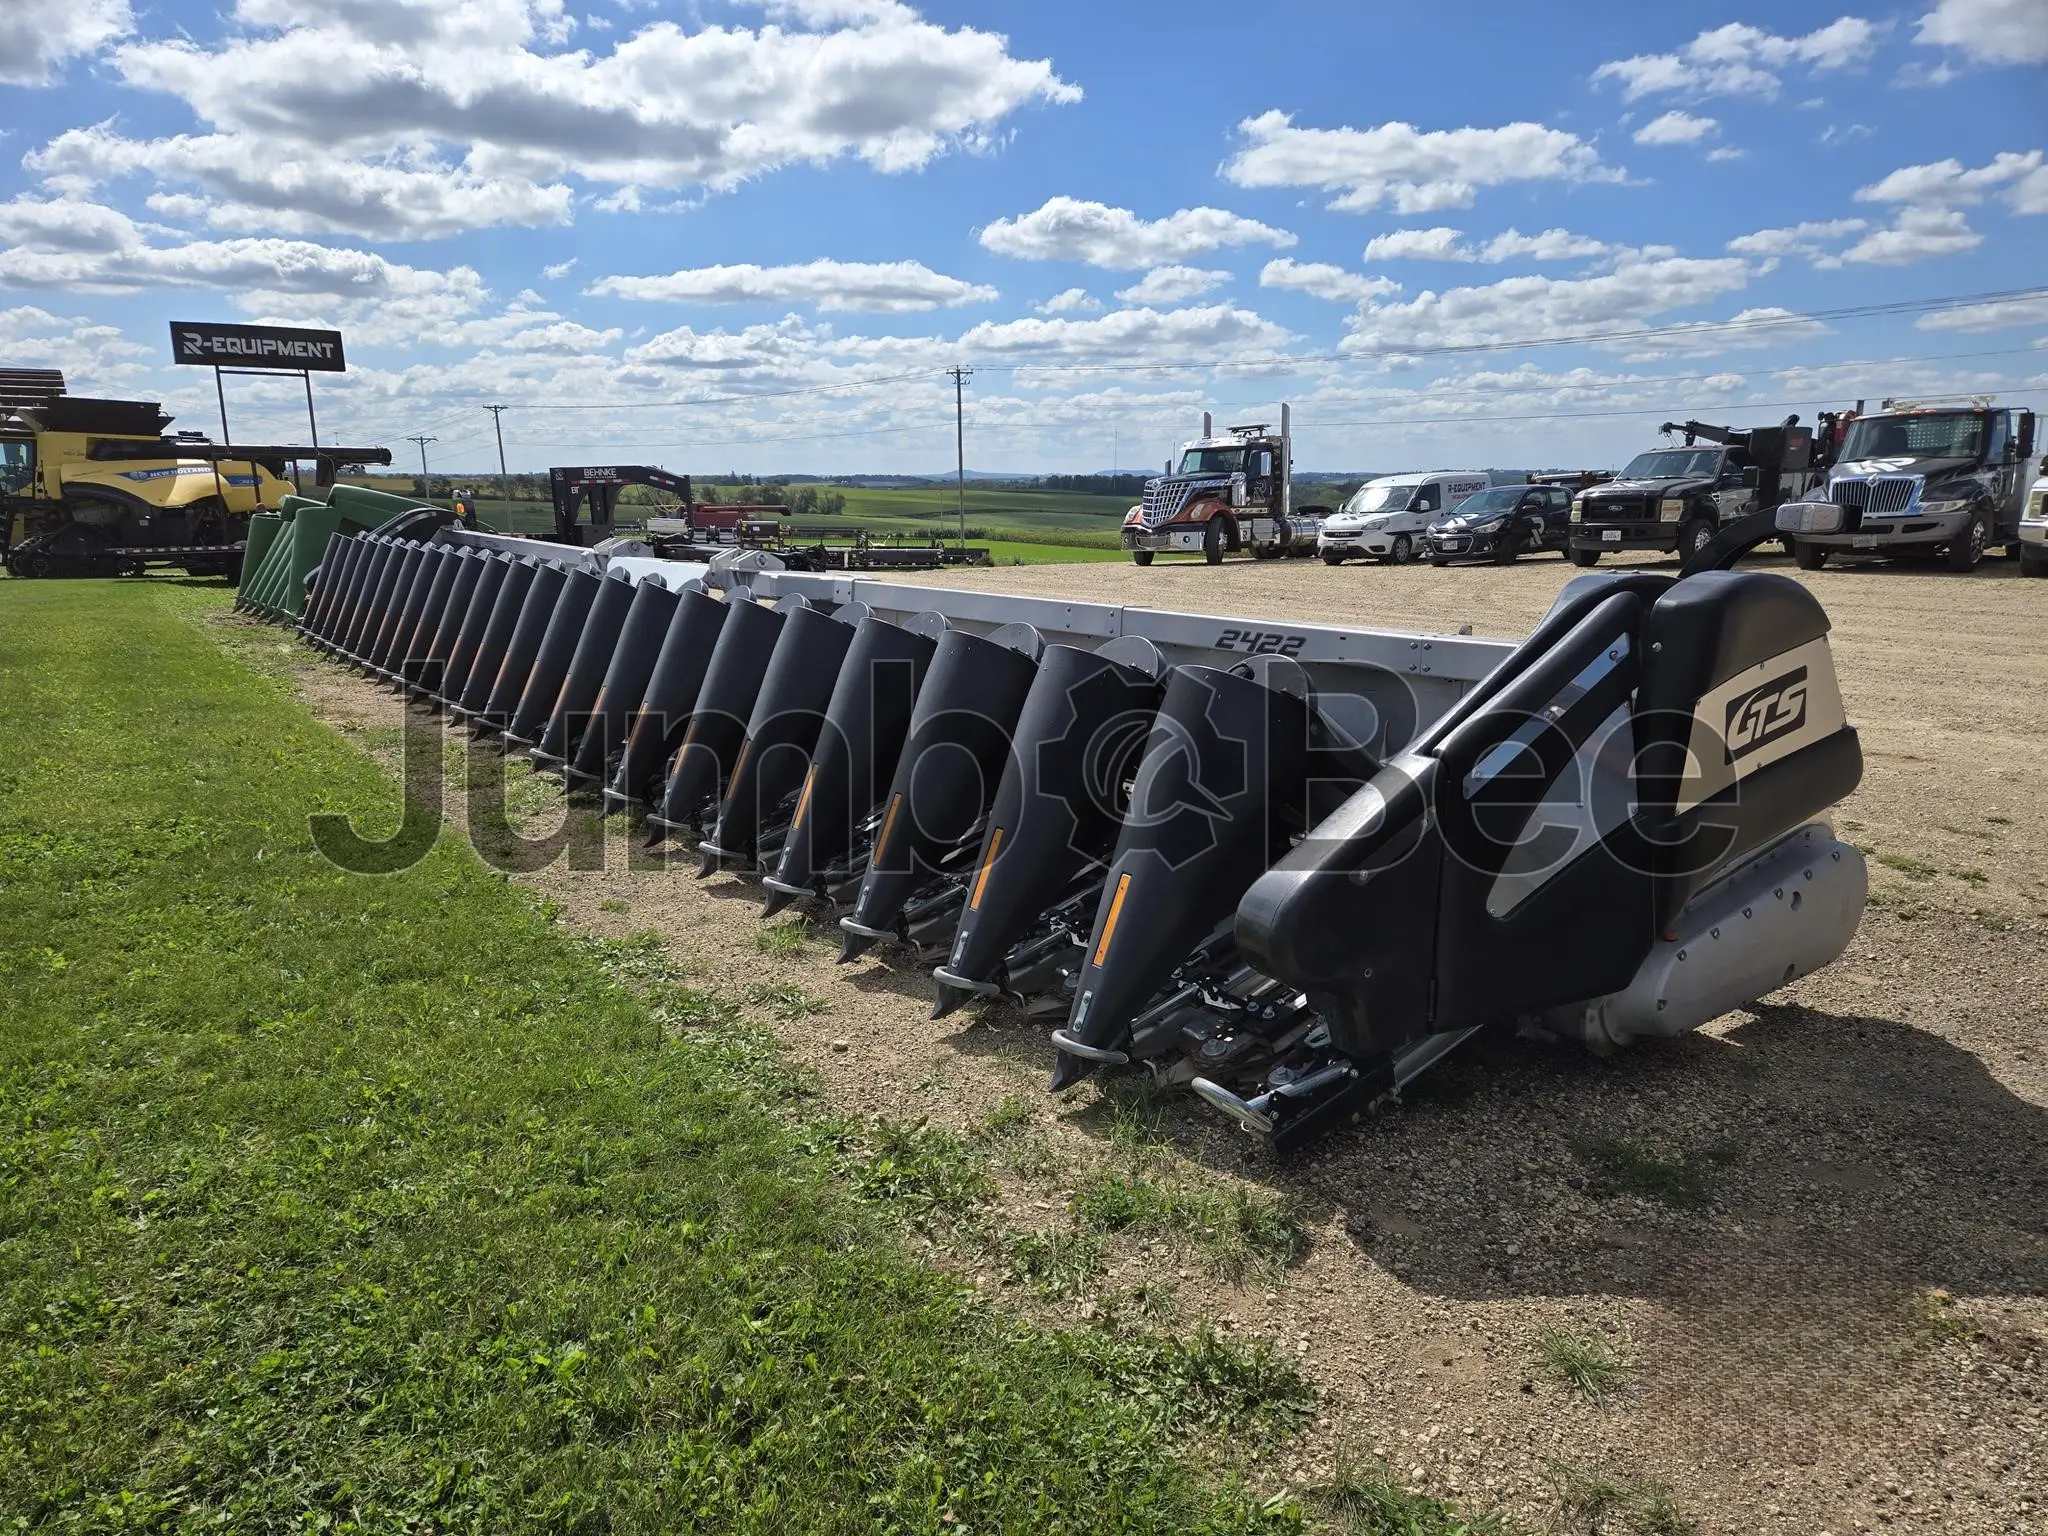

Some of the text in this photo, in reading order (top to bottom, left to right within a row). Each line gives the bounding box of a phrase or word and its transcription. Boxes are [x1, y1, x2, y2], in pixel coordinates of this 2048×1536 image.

[182, 332, 334, 359] R-EQUIPMENT
[584, 468, 617, 476] BEHNKE
[1448, 482, 1486, 494] R-EQUIPMENT
[1214, 629, 1307, 658] 2422
[1727, 680, 1808, 751] GTS
